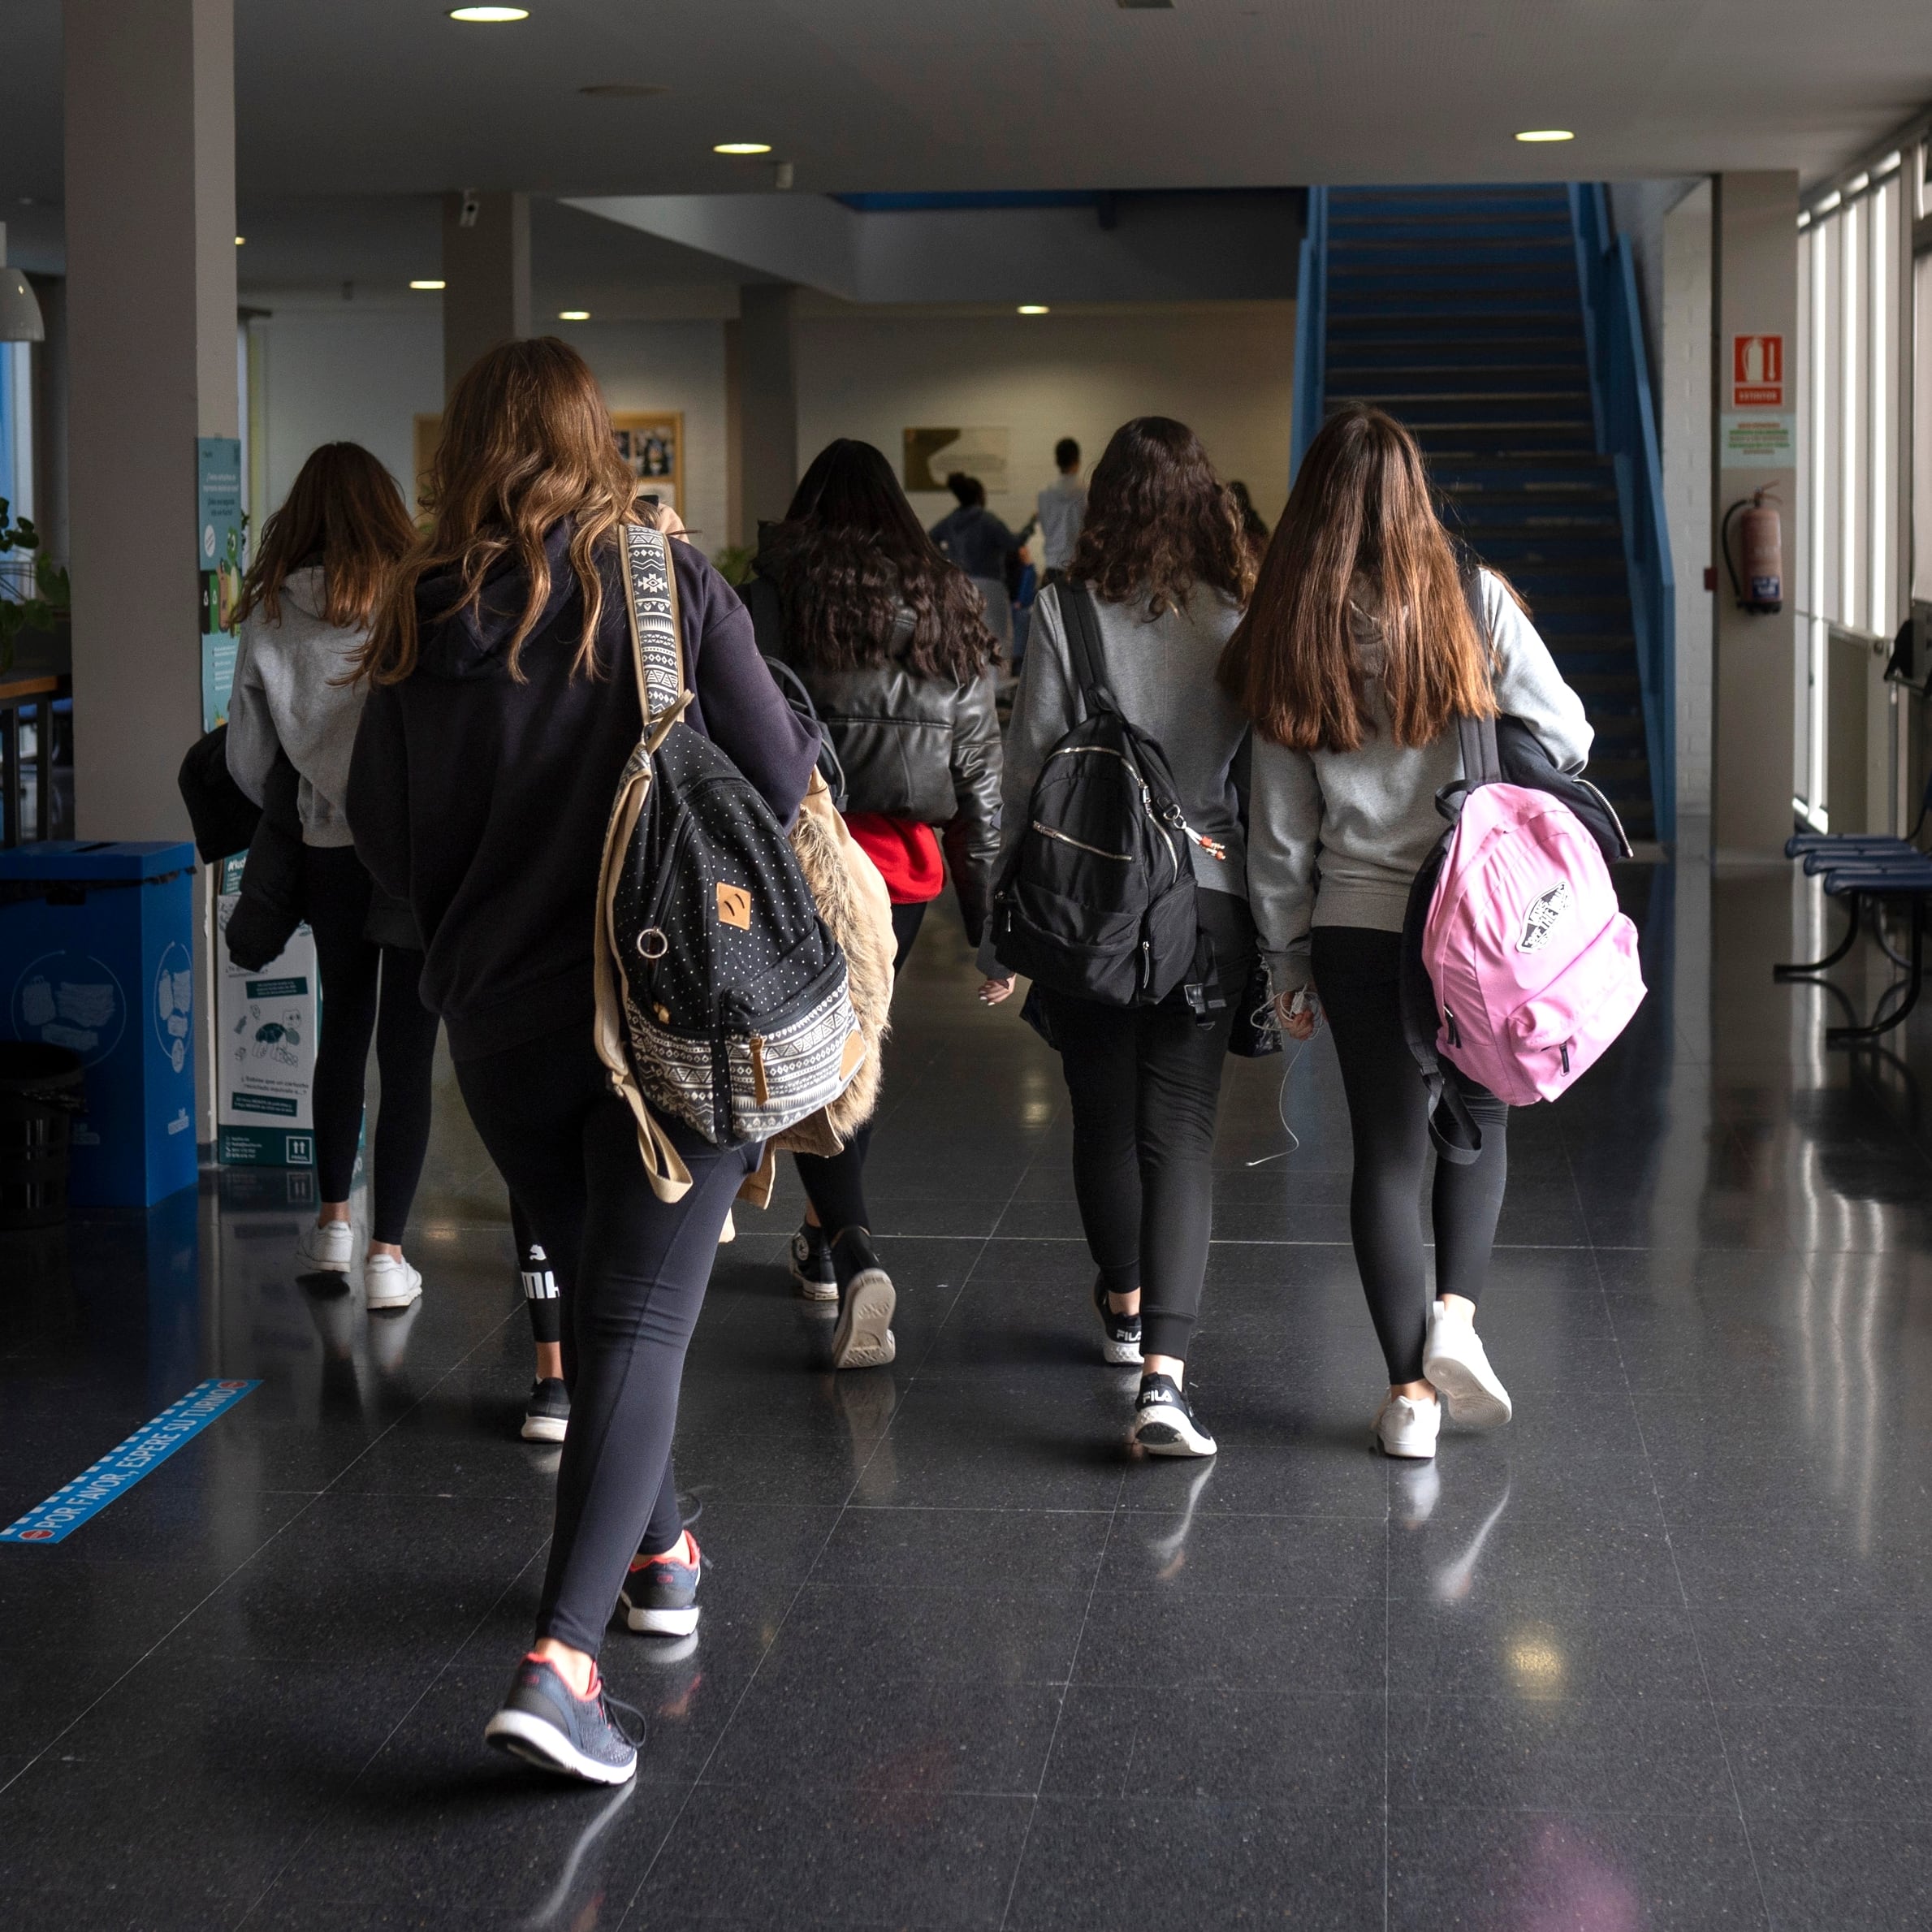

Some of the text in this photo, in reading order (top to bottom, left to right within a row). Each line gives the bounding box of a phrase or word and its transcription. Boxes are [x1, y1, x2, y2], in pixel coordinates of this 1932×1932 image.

[1143, 1390, 1173, 1404] FILA
[34, 1389, 237, 1528] POR FAVOR, ESPERE SU TURNO
